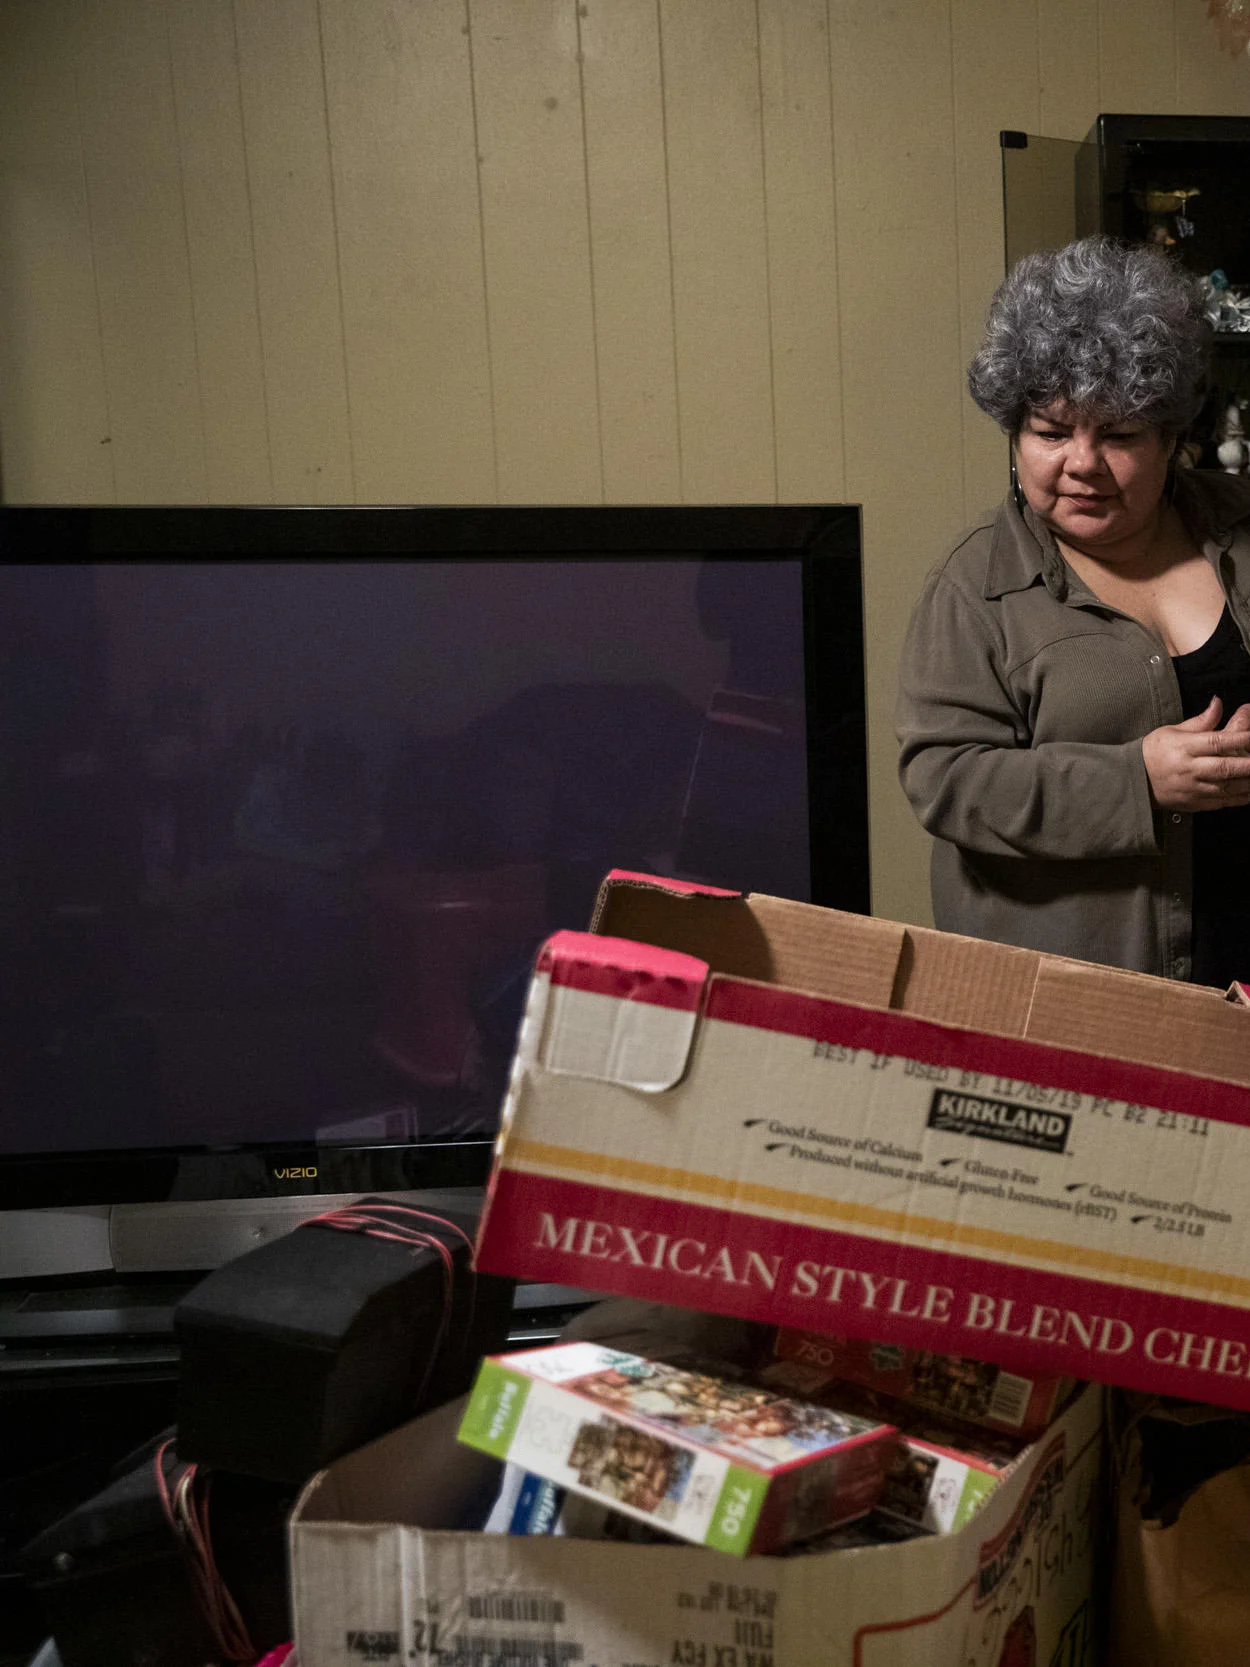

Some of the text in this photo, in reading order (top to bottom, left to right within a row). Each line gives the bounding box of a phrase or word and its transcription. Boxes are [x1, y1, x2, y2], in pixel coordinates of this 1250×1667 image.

[904, 1057, 949, 1082] USED
[937, 1093, 1066, 1137] KIRKLAND
[274, 1166, 318, 1179] VIZIO
[768, 1120, 807, 1139] Good
[806, 1128, 850, 1149] Source
[854, 1138, 870, 1151] of
[870, 1140, 923, 1163] Calcium
[963, 1160, 1009, 1180] Gluten
[1089, 1184, 1126, 1203] Good
[1128, 1191, 1170, 1212] Source
[789, 1144, 853, 1169] Produced
[854, 1158, 904, 1179] without
[958, 1180, 1005, 1200] growth
[1007, 1186, 1072, 1211] hormones
[535, 1212, 784, 1290] MEXICAN
[791, 1260, 955, 1324] STYLE
[963, 1286, 1134, 1357] BLEND
[720, 1486, 752, 1536] 750
